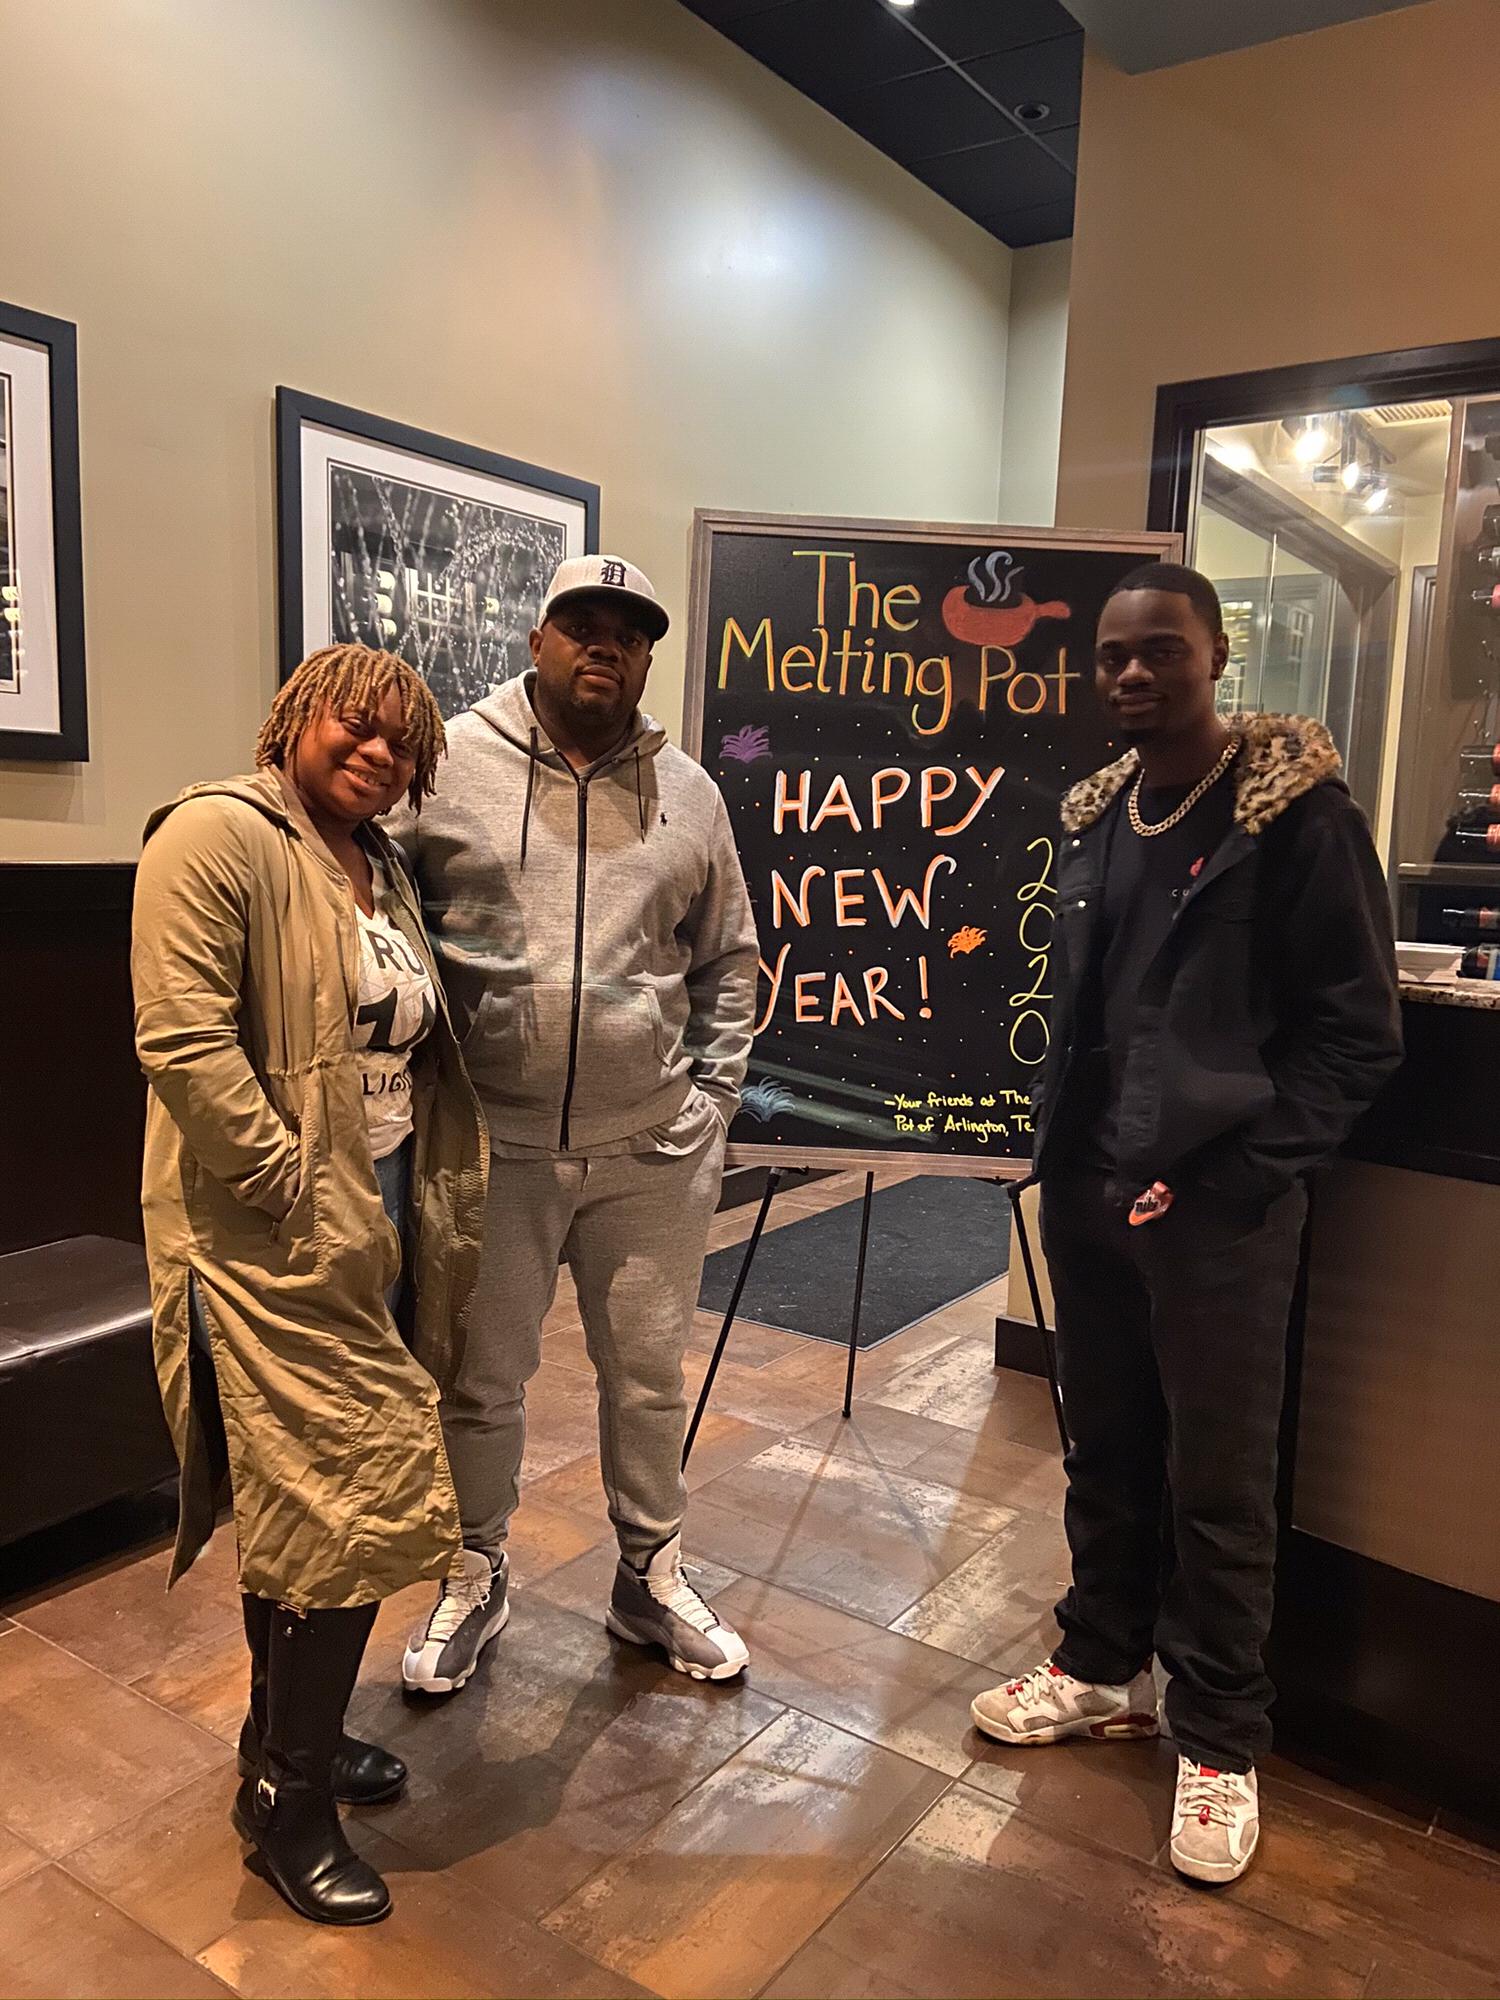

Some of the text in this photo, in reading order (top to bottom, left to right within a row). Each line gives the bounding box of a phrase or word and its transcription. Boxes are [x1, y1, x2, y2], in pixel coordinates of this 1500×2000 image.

[600, 559, 627, 588] D
[793, 551, 921, 632] The
[718, 617, 1081, 735] Melting Pot
[773, 766, 1006, 837] HAPPY
[772, 854, 957, 930] NEW
[753, 943, 932, 1037] YEAR!
[894, 1114, 915, 1132] Pot
[917, 1117, 935, 1132] of
[944, 1114, 1009, 1144] Arlington,
[927, 1091, 974, 1108] friends
[980, 1094, 996, 1107] at
[999, 1090, 1033, 1106] The
